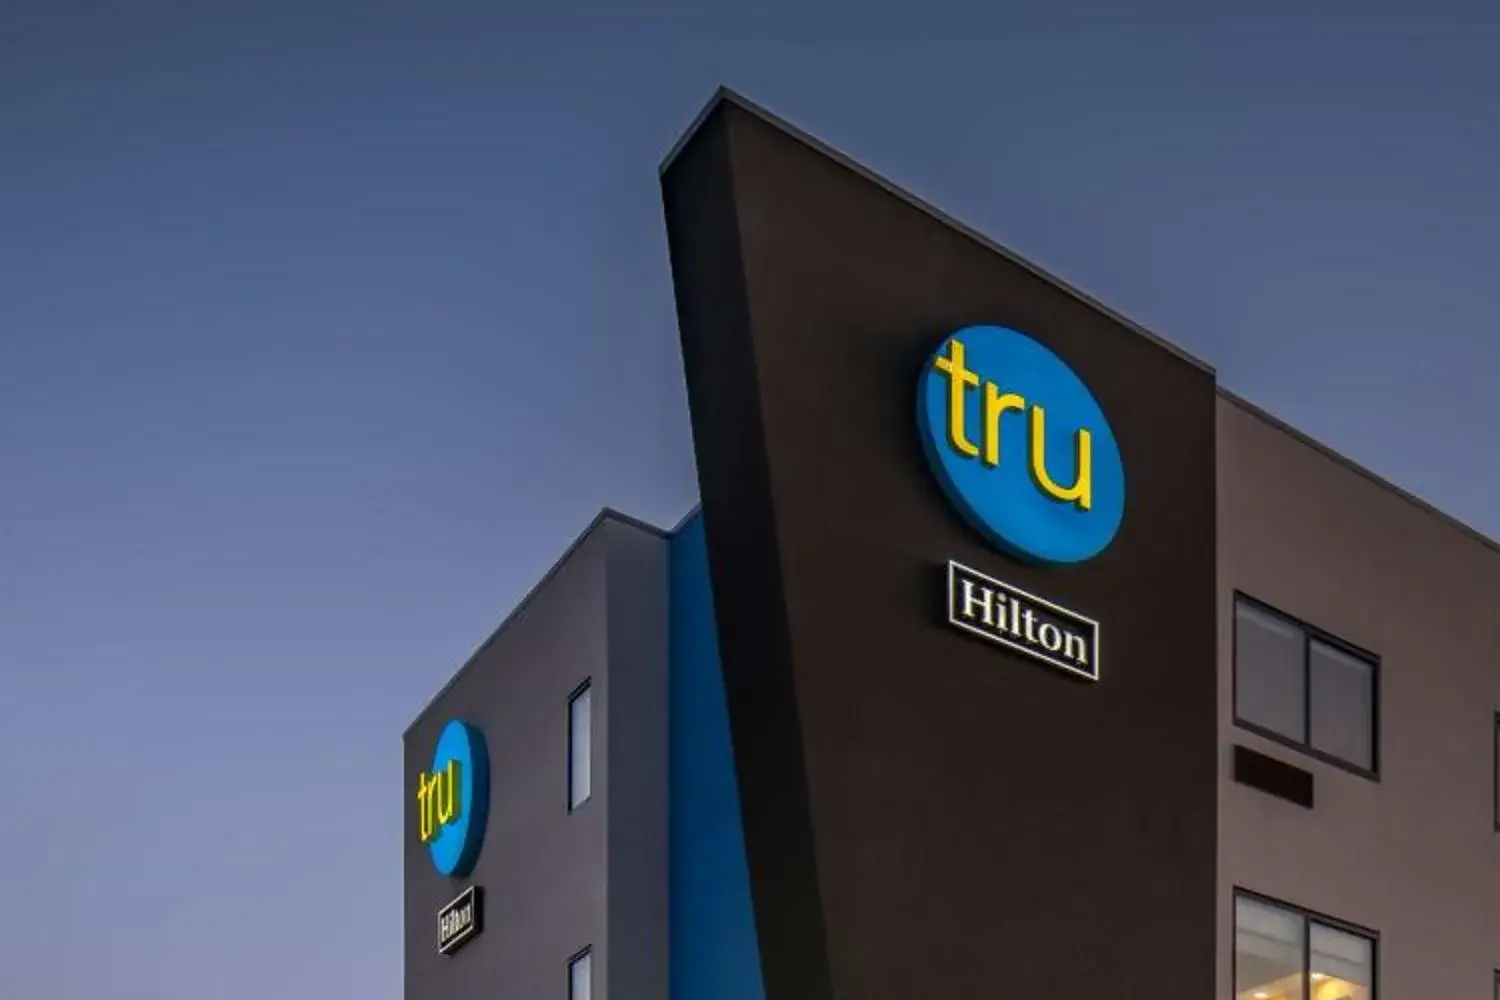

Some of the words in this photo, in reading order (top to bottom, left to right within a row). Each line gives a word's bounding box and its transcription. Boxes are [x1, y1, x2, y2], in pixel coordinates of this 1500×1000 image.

[934, 339, 1092, 509] tru
[961, 578, 1088, 664] Hilton
[417, 759, 458, 842] tru
[441, 903, 471, 942] Hilton
